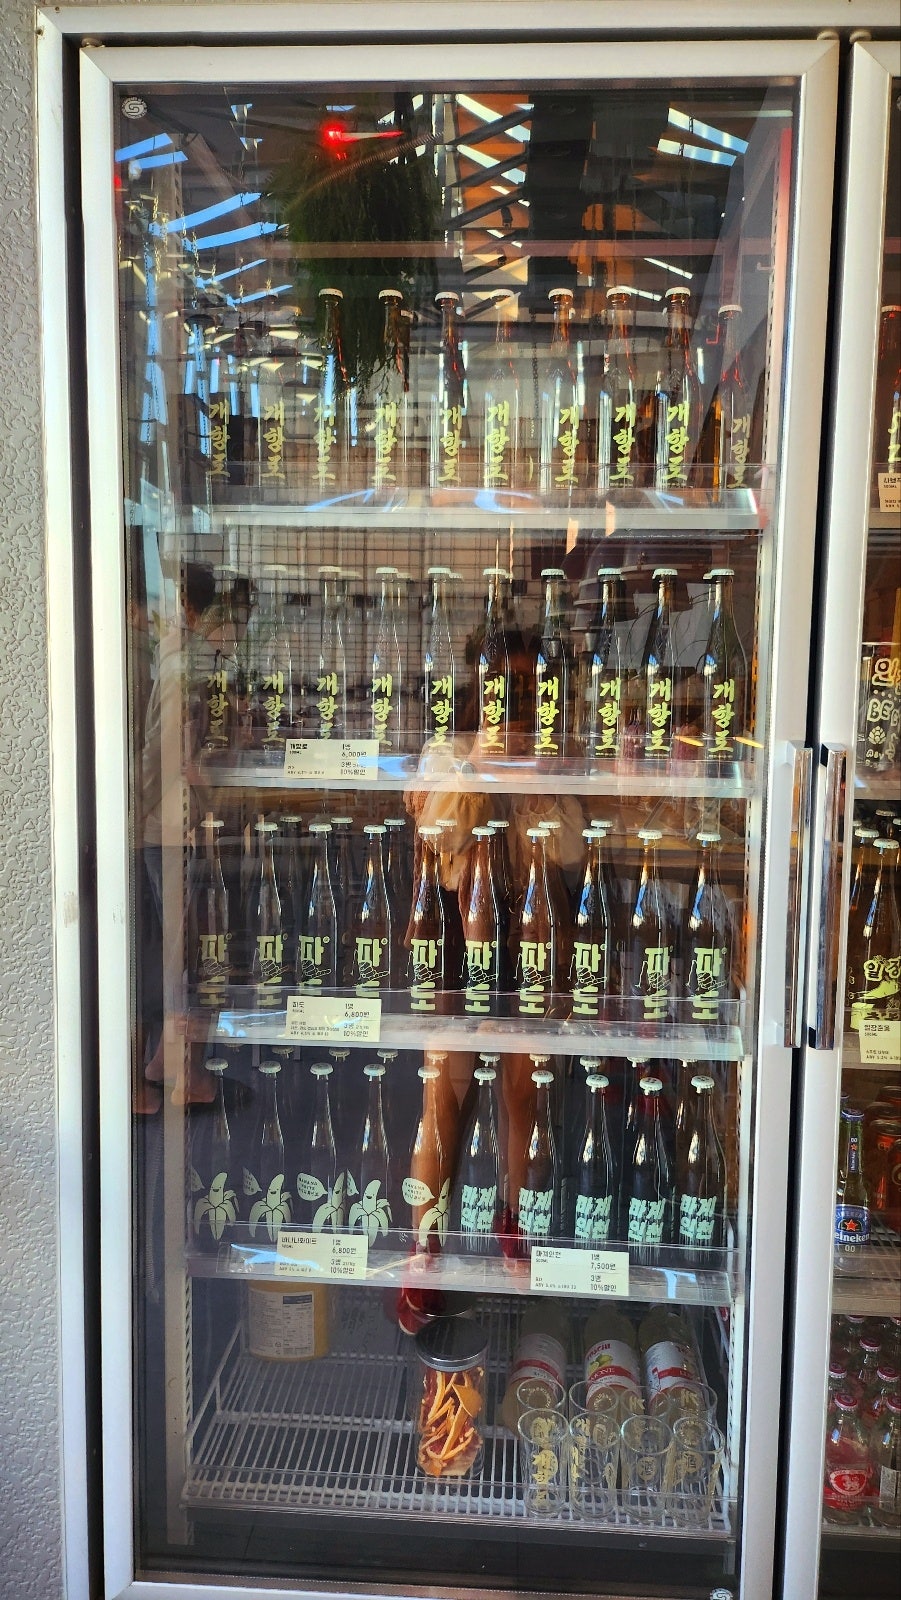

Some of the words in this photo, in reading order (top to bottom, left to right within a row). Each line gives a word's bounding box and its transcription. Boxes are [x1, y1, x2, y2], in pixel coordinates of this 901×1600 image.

[206, 399, 230, 477] 개항로
[262, 399, 286, 479] 개항로
[372, 402, 397, 481] 개항로
[437, 404, 462, 482] 개항로
[484, 400, 510, 481] 개항로
[555, 404, 580, 482] 개항로
[610, 402, 637, 481] 개항로
[664, 401, 690, 481] 개항로
[727, 412, 751, 488] 개항로
[205, 670, 229, 742] 개항로
[262, 670, 286, 742] 개항로
[316, 672, 338, 740] 개항로
[372, 674, 393, 746] 개항로
[428, 674, 454, 748] 개항로
[480, 676, 505, 748] 개항로
[534, 677, 560, 750] 개항로
[595, 677, 621, 750] 개항로
[645, 678, 672, 751] 개항로
[708, 678, 735, 752] 개항로
[591, 1262, 616, 1270] 7,500원
[835, 1230, 870, 1243] eineken
